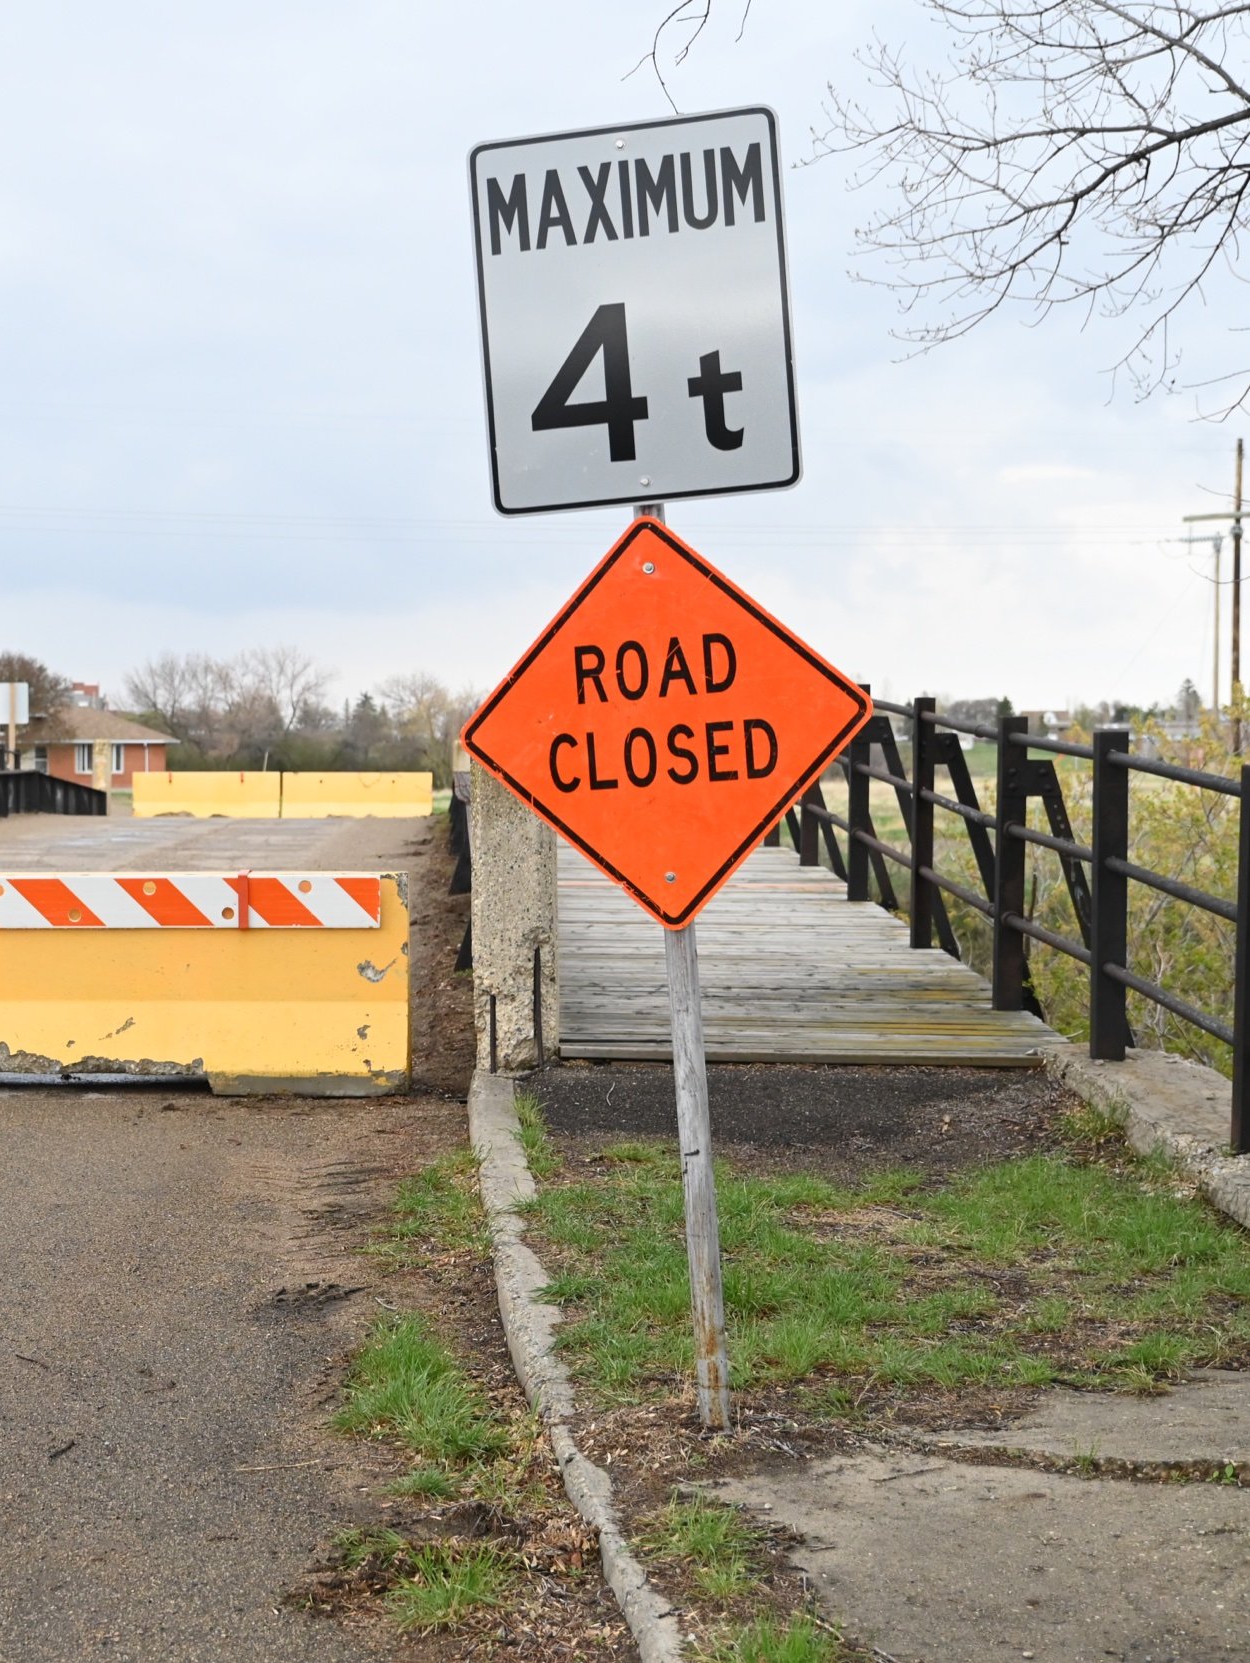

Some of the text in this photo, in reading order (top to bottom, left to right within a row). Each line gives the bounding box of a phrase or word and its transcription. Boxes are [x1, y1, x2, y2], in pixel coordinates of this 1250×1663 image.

[485, 142, 766, 256] MAXIMUM
[531, 302, 745, 463] 4 t
[574, 632, 737, 705] ROAD
[549, 718, 779, 793] CLOSED
